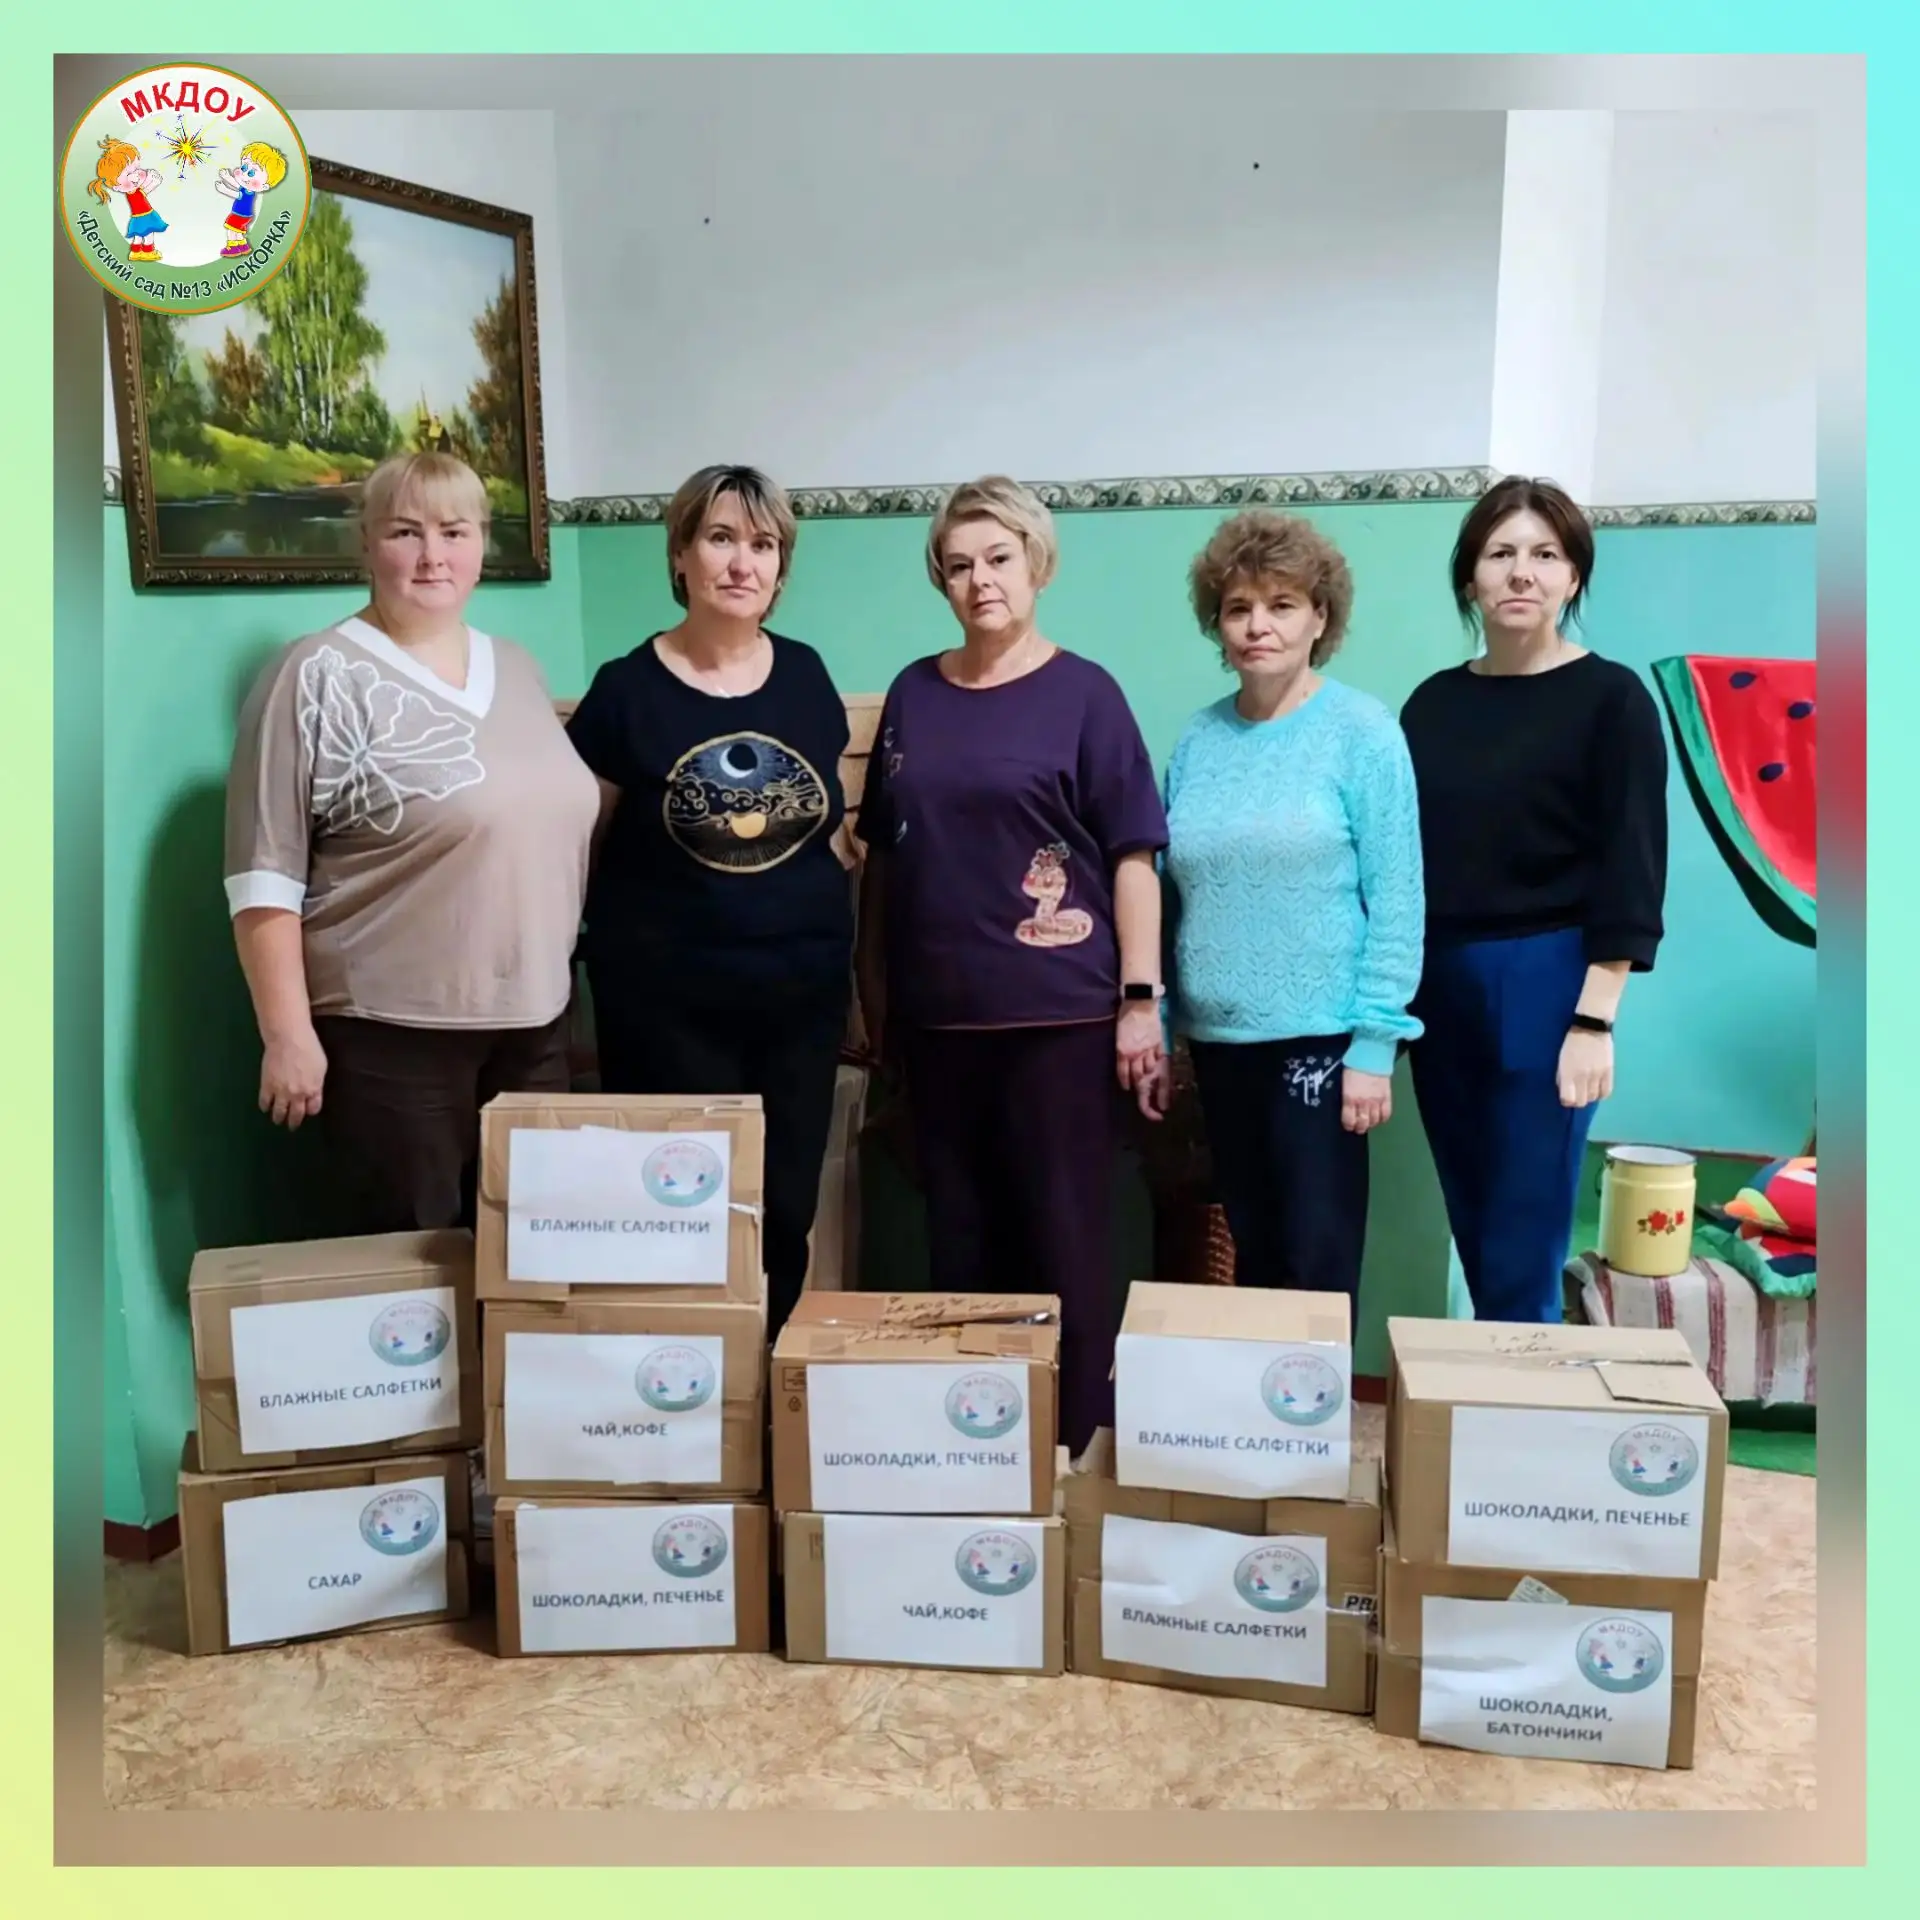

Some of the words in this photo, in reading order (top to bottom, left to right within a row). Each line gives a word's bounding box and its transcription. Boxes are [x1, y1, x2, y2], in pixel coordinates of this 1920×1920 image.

[530, 1219, 617, 1234] ВЛАЖНЫЕ
[621, 1220, 710, 1235] САЛФЕТКИ
[259, 1387, 347, 1409] ВЛАЖНЫЕ
[352, 1377, 442, 1400] САЛФЕТКИ
[582, 1422, 669, 1439] ЧАЙ,КОФЕ
[1138, 1431, 1229, 1449] ВЛАЖНЫЕ
[1234, 1437, 1330, 1455] САЛФЕТКИ
[824, 1452, 942, 1468] ШОКОЛАДКИ,
[946, 1452, 1020, 1466] ПЕЧЕНЬЕ
[1464, 1502, 1600, 1524] ШОКОЛАДКИ,
[1605, 1509, 1691, 1527] ПЕЧЕНЬЕ
[308, 1573, 362, 1590] САХАР
[532, 1593, 648, 1608] ШОКОЛАДКИ,
[653, 1589, 725, 1604] ПЕЧЕНЬЕ
[902, 1603, 988, 1621] ЧАЙ,КОФЕ
[1121, 1607, 1209, 1633] ВЛАЖНЫЕ
[1213, 1621, 1307, 1639] САЛФЕТКИ
[1479, 1696, 1613, 1722] ШОКОЛАДКИ,
[1486, 1721, 1603, 1742] БАТОНЧИКИ
